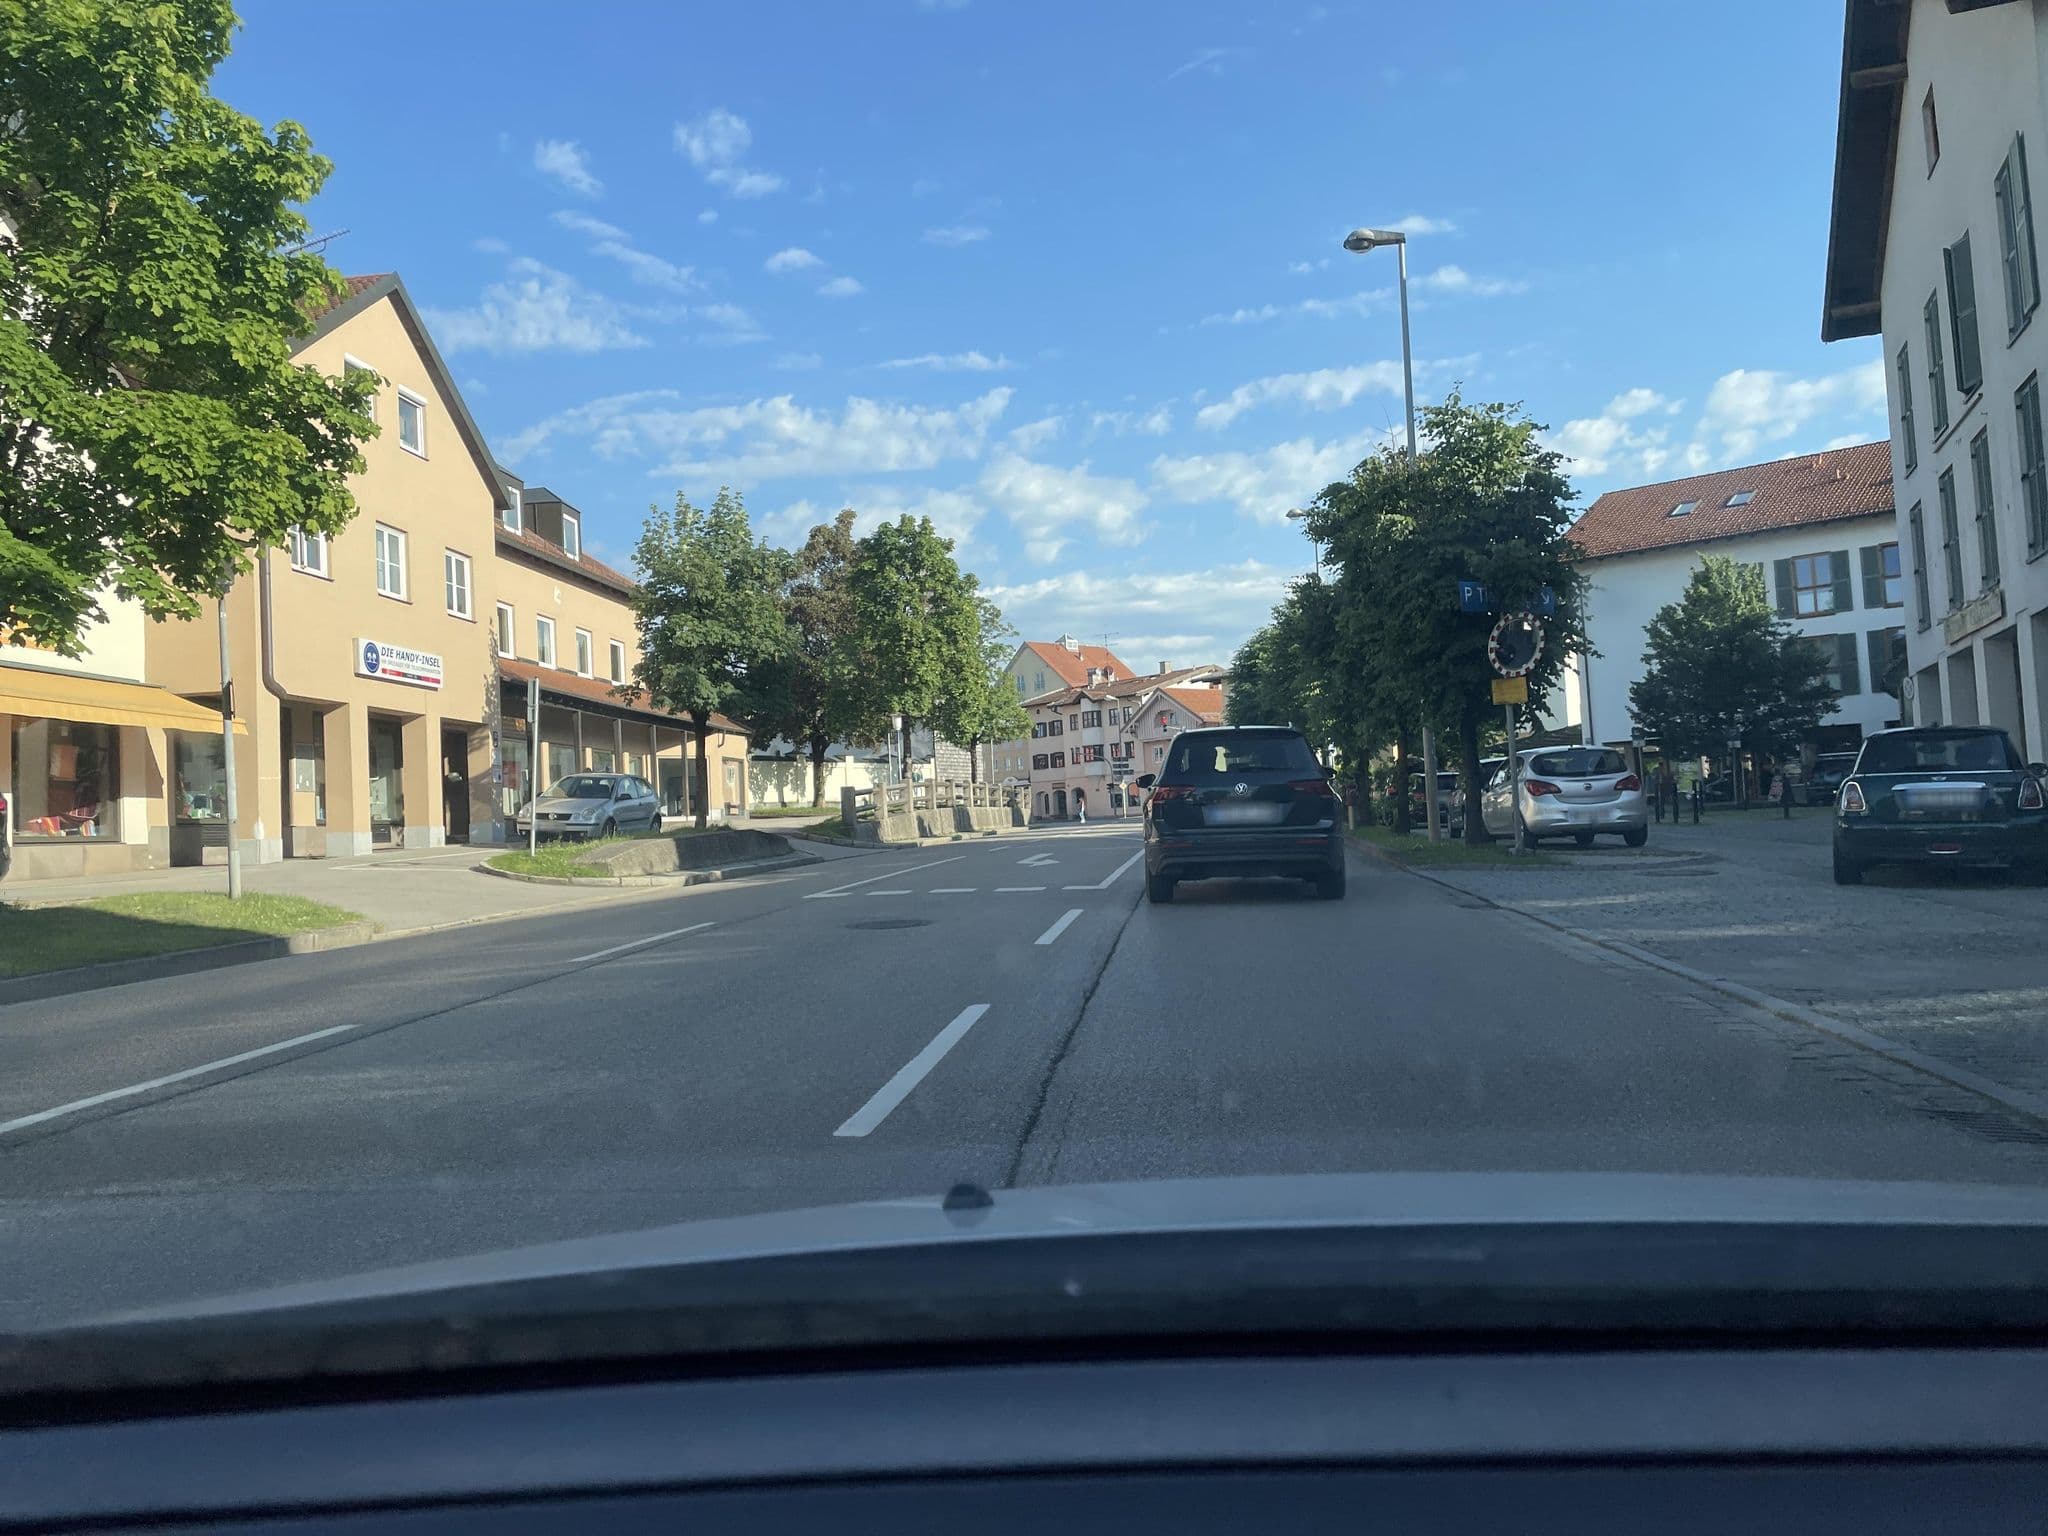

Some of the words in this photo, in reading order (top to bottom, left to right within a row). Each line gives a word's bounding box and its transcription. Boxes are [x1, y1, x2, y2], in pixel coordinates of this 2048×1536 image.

[1464, 586, 1473, 603] P
[381, 646, 394, 658] DIE
[395, 649, 441, 668] HANDY-INSEL
